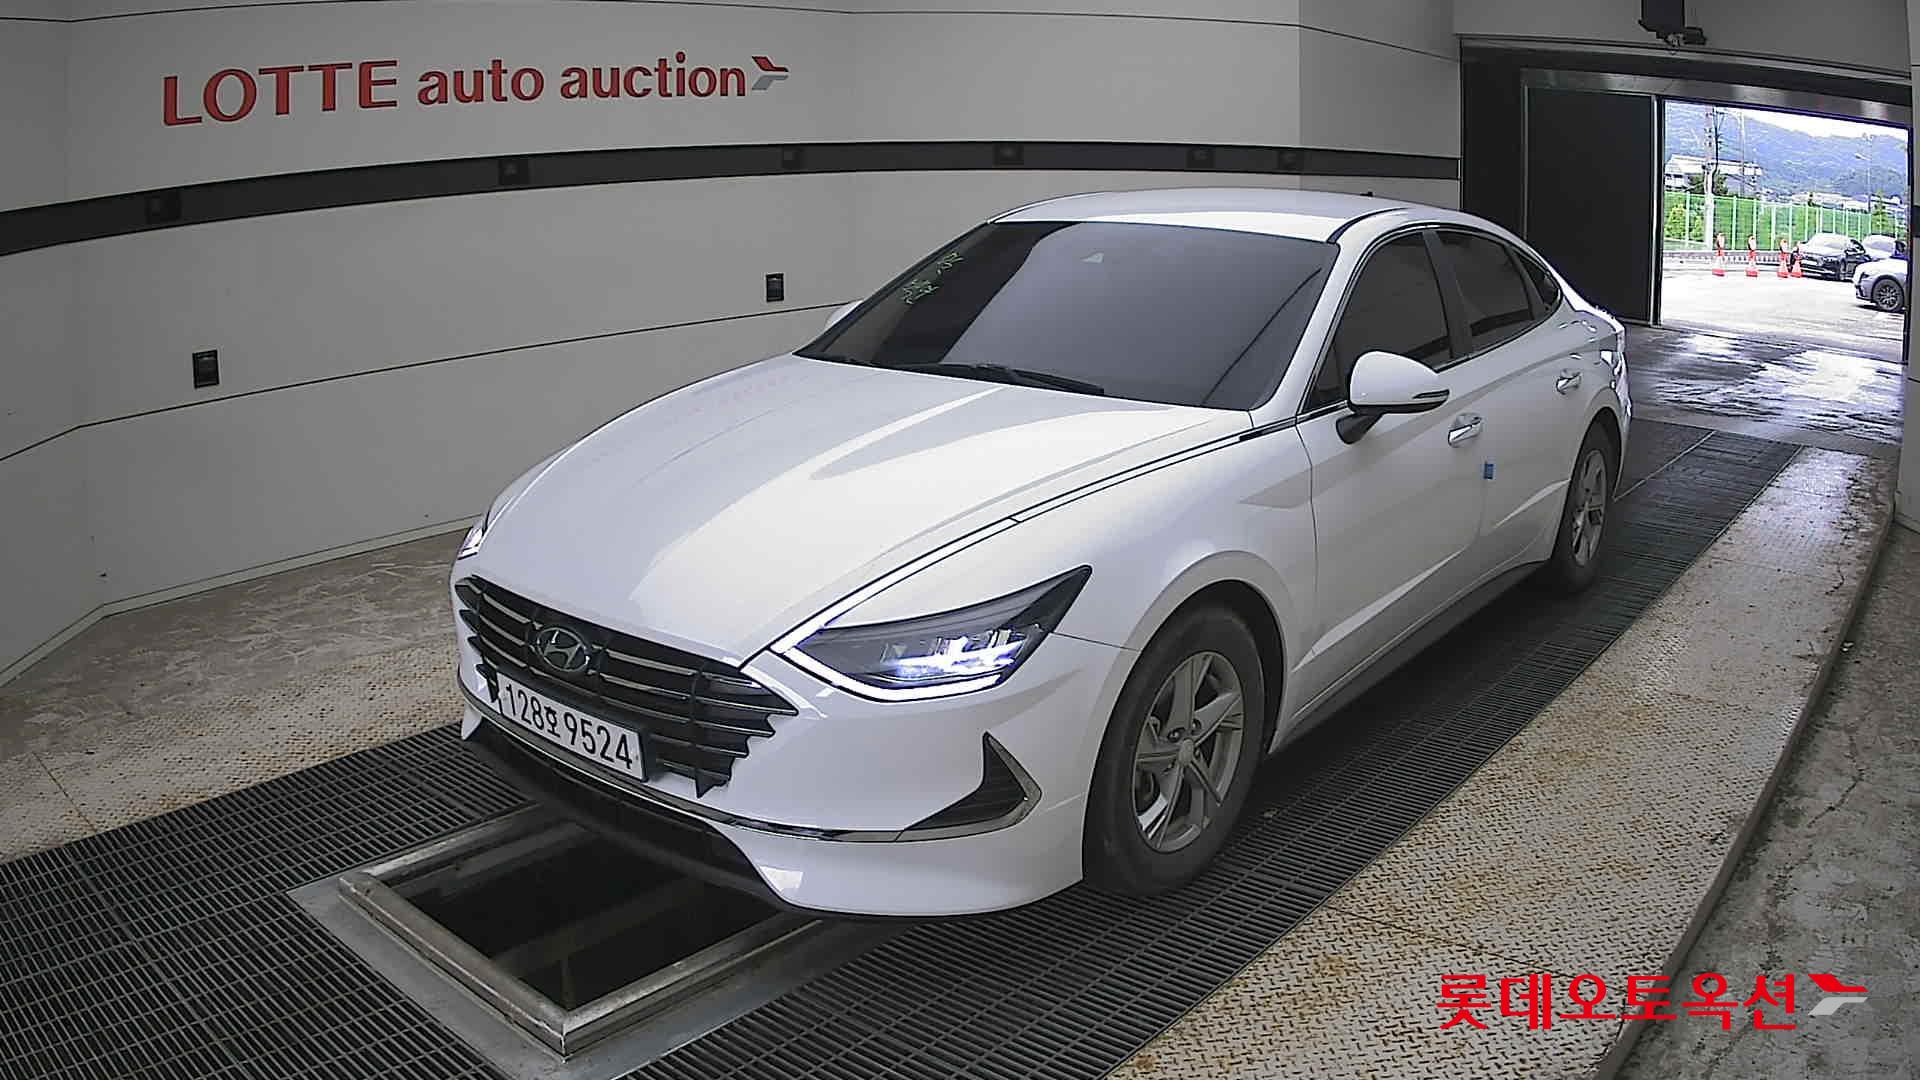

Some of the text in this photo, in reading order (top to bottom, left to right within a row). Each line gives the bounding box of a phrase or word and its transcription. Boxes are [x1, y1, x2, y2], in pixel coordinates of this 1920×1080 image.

[162, 50, 746, 126] LOTTE auto auction
